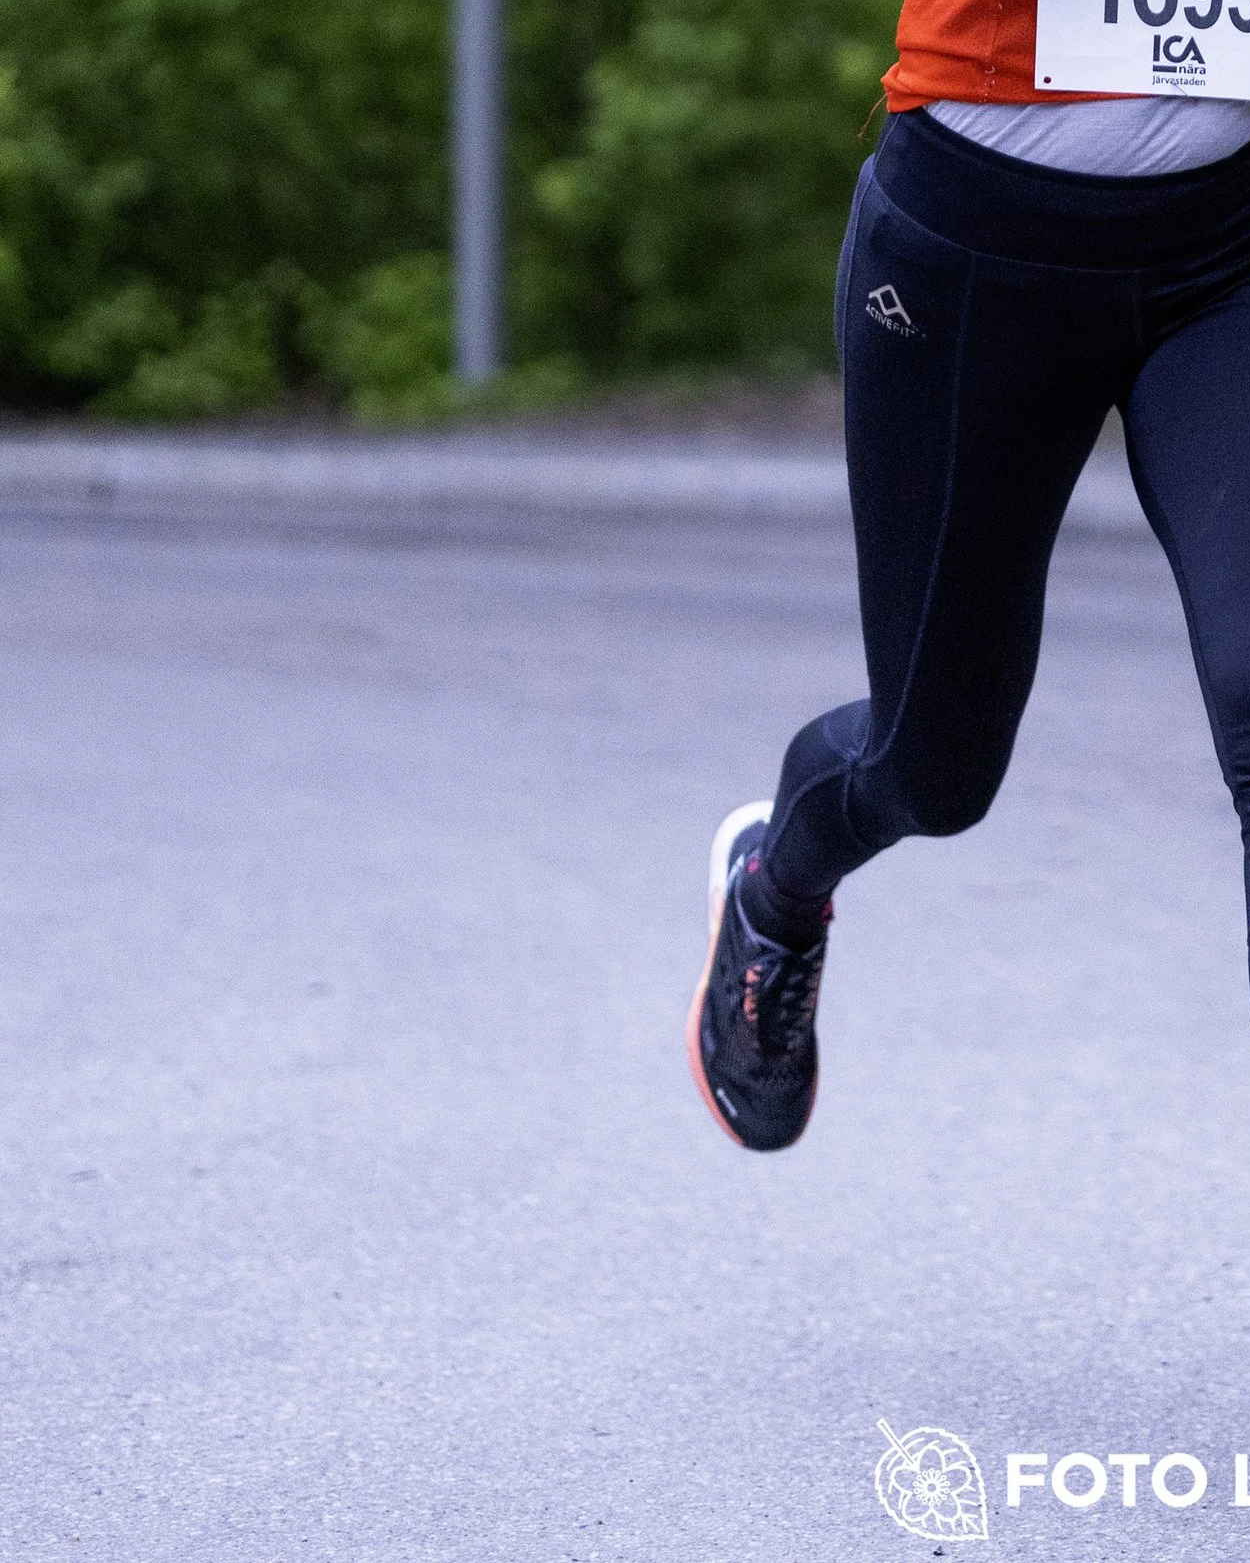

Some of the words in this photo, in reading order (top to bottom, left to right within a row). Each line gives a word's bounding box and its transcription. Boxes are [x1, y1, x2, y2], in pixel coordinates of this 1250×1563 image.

[1153, 34, 1206, 65] ICA
[1178, 64, 1207, 75] nära
[1152, 75, 1206, 86] Järvastaden
